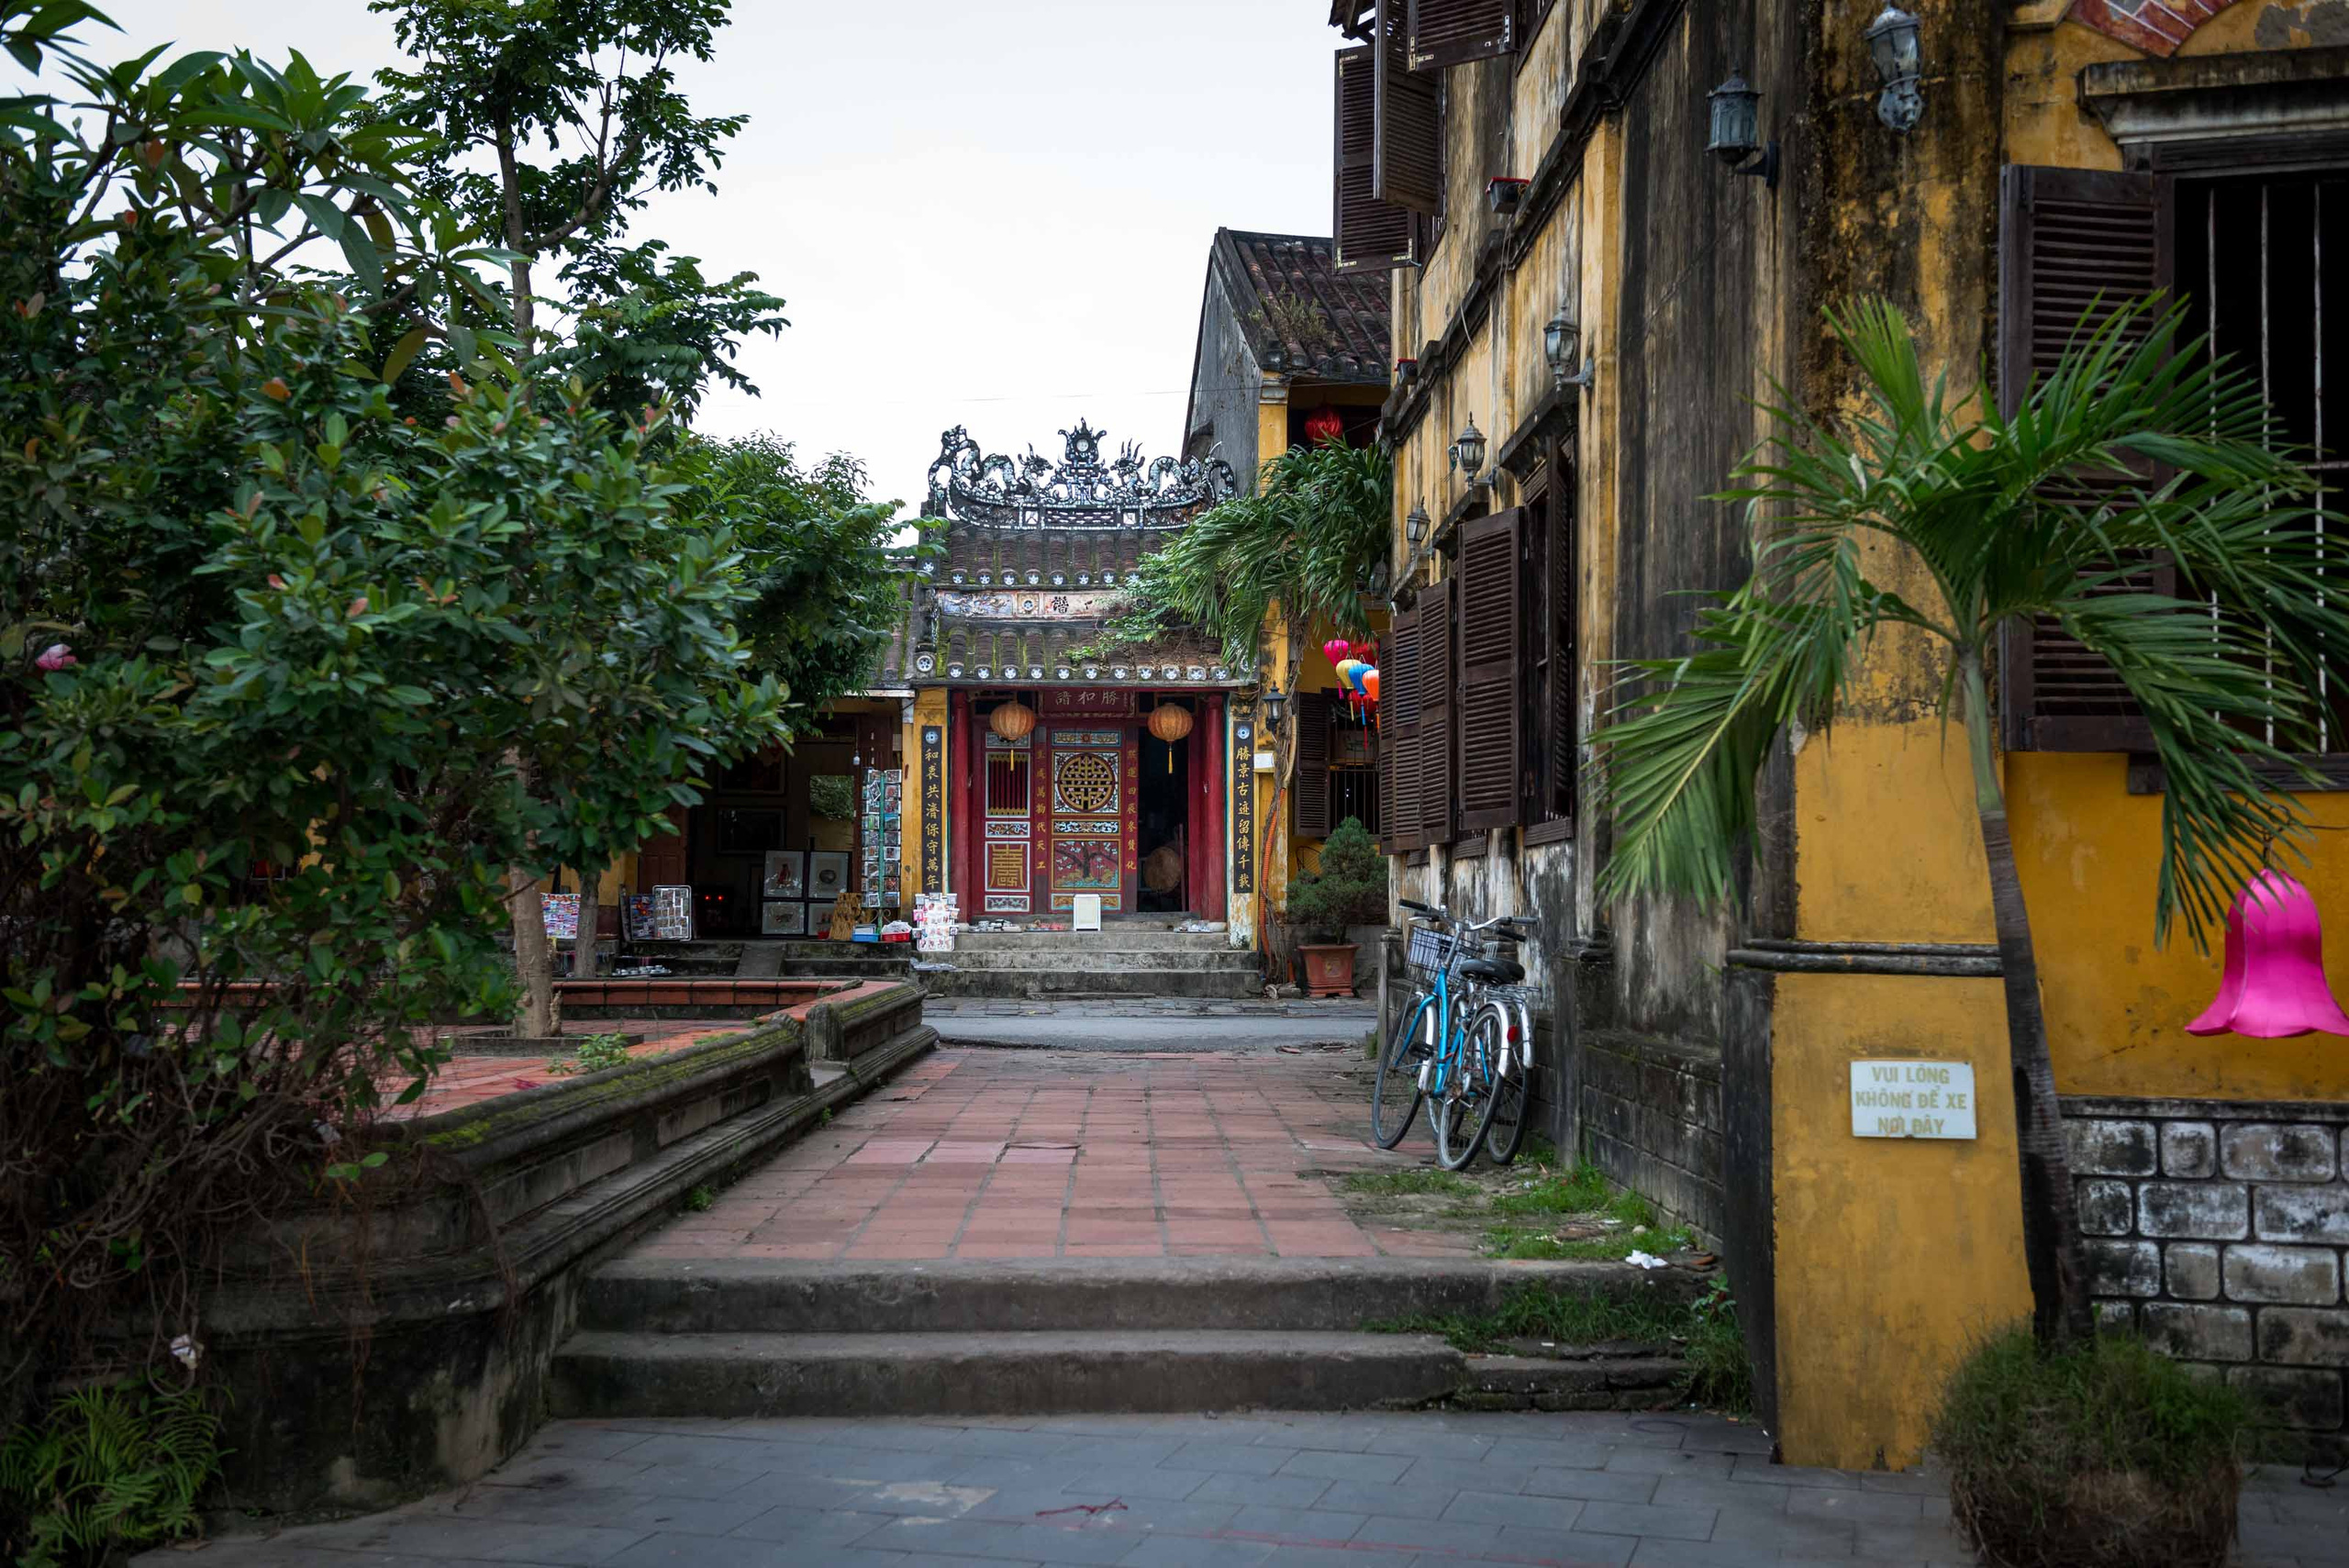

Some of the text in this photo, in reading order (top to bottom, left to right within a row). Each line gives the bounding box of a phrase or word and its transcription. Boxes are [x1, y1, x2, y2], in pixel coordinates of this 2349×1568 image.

[1872, 1066, 1898, 1083] VUI
[1855, 1085, 1967, 1109] KHÔNG ĐỂ XE
[1911, 1114, 1944, 1134] ĐÂY
